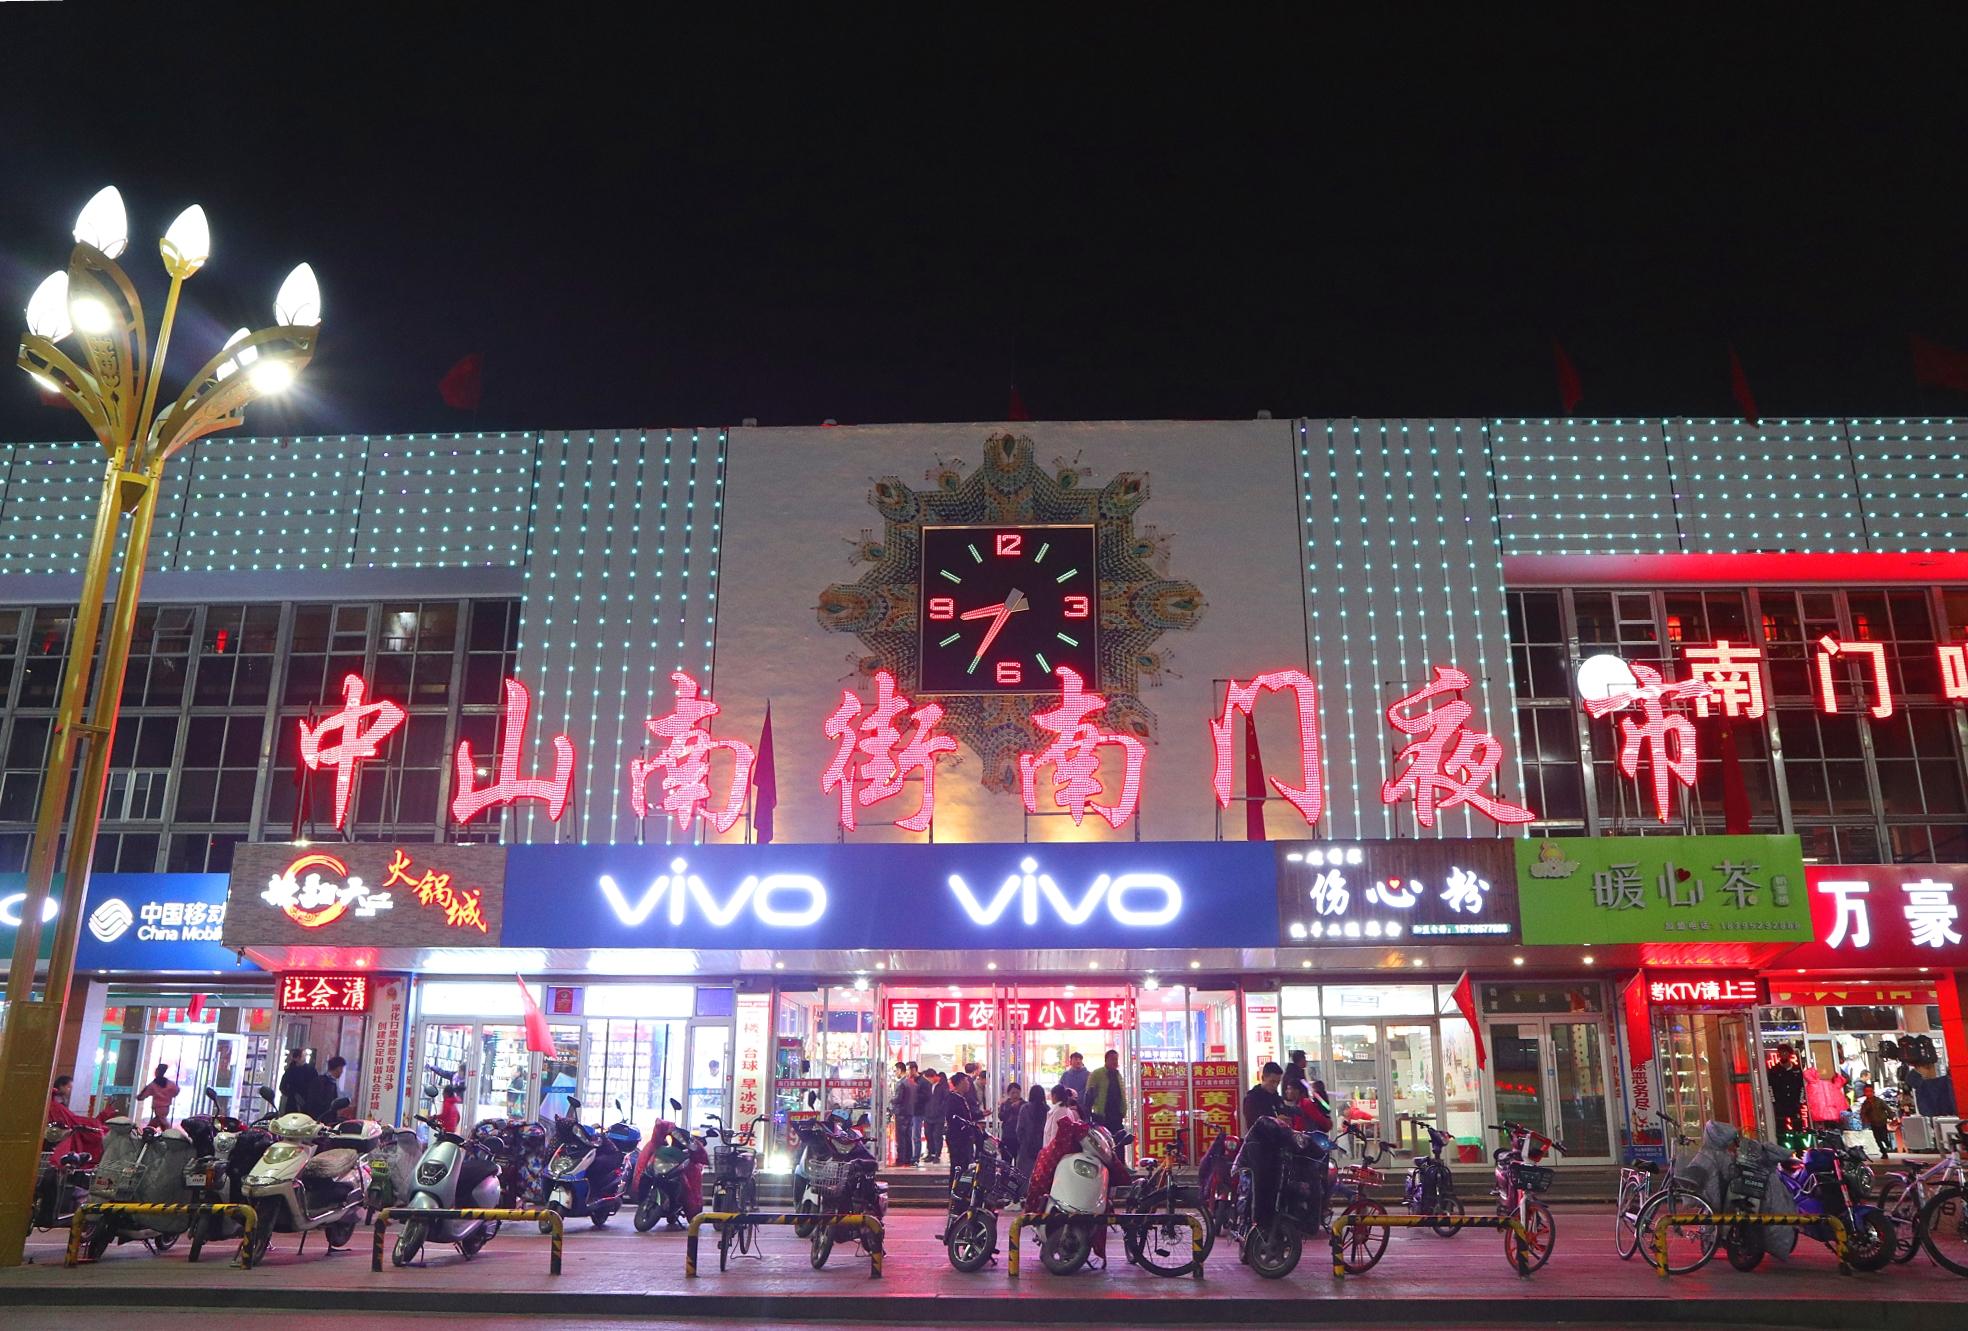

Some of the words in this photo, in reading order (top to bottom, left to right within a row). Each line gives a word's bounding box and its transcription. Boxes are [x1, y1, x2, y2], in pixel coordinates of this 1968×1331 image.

[997, 534, 1021, 556] 12
[930, 598, 954, 619] 9
[1064, 596, 1089, 617] 3
[997, 662, 1021, 683] 6
[1685, 635, 1968, 719] 南门
[382, 849, 488, 933] 火锅城
[598, 857, 828, 926] vivo
[948, 857, 1182, 926] vivo
[1310, 866, 1490, 915] 伤心粉
[1592, 861, 1761, 910] 暖心茶
[140, 901, 227, 926] 中国移动
[1817, 879, 1962, 948] 万豪
[137, 925, 178, 941] China
[182, 925, 224, 941] Mobil
[892, 1001, 1136, 1028] 南门夜市小吃城
[1193, 1064, 1238, 1077] 黄金回收
[1201, 1091, 1234, 1154] 黄金回
